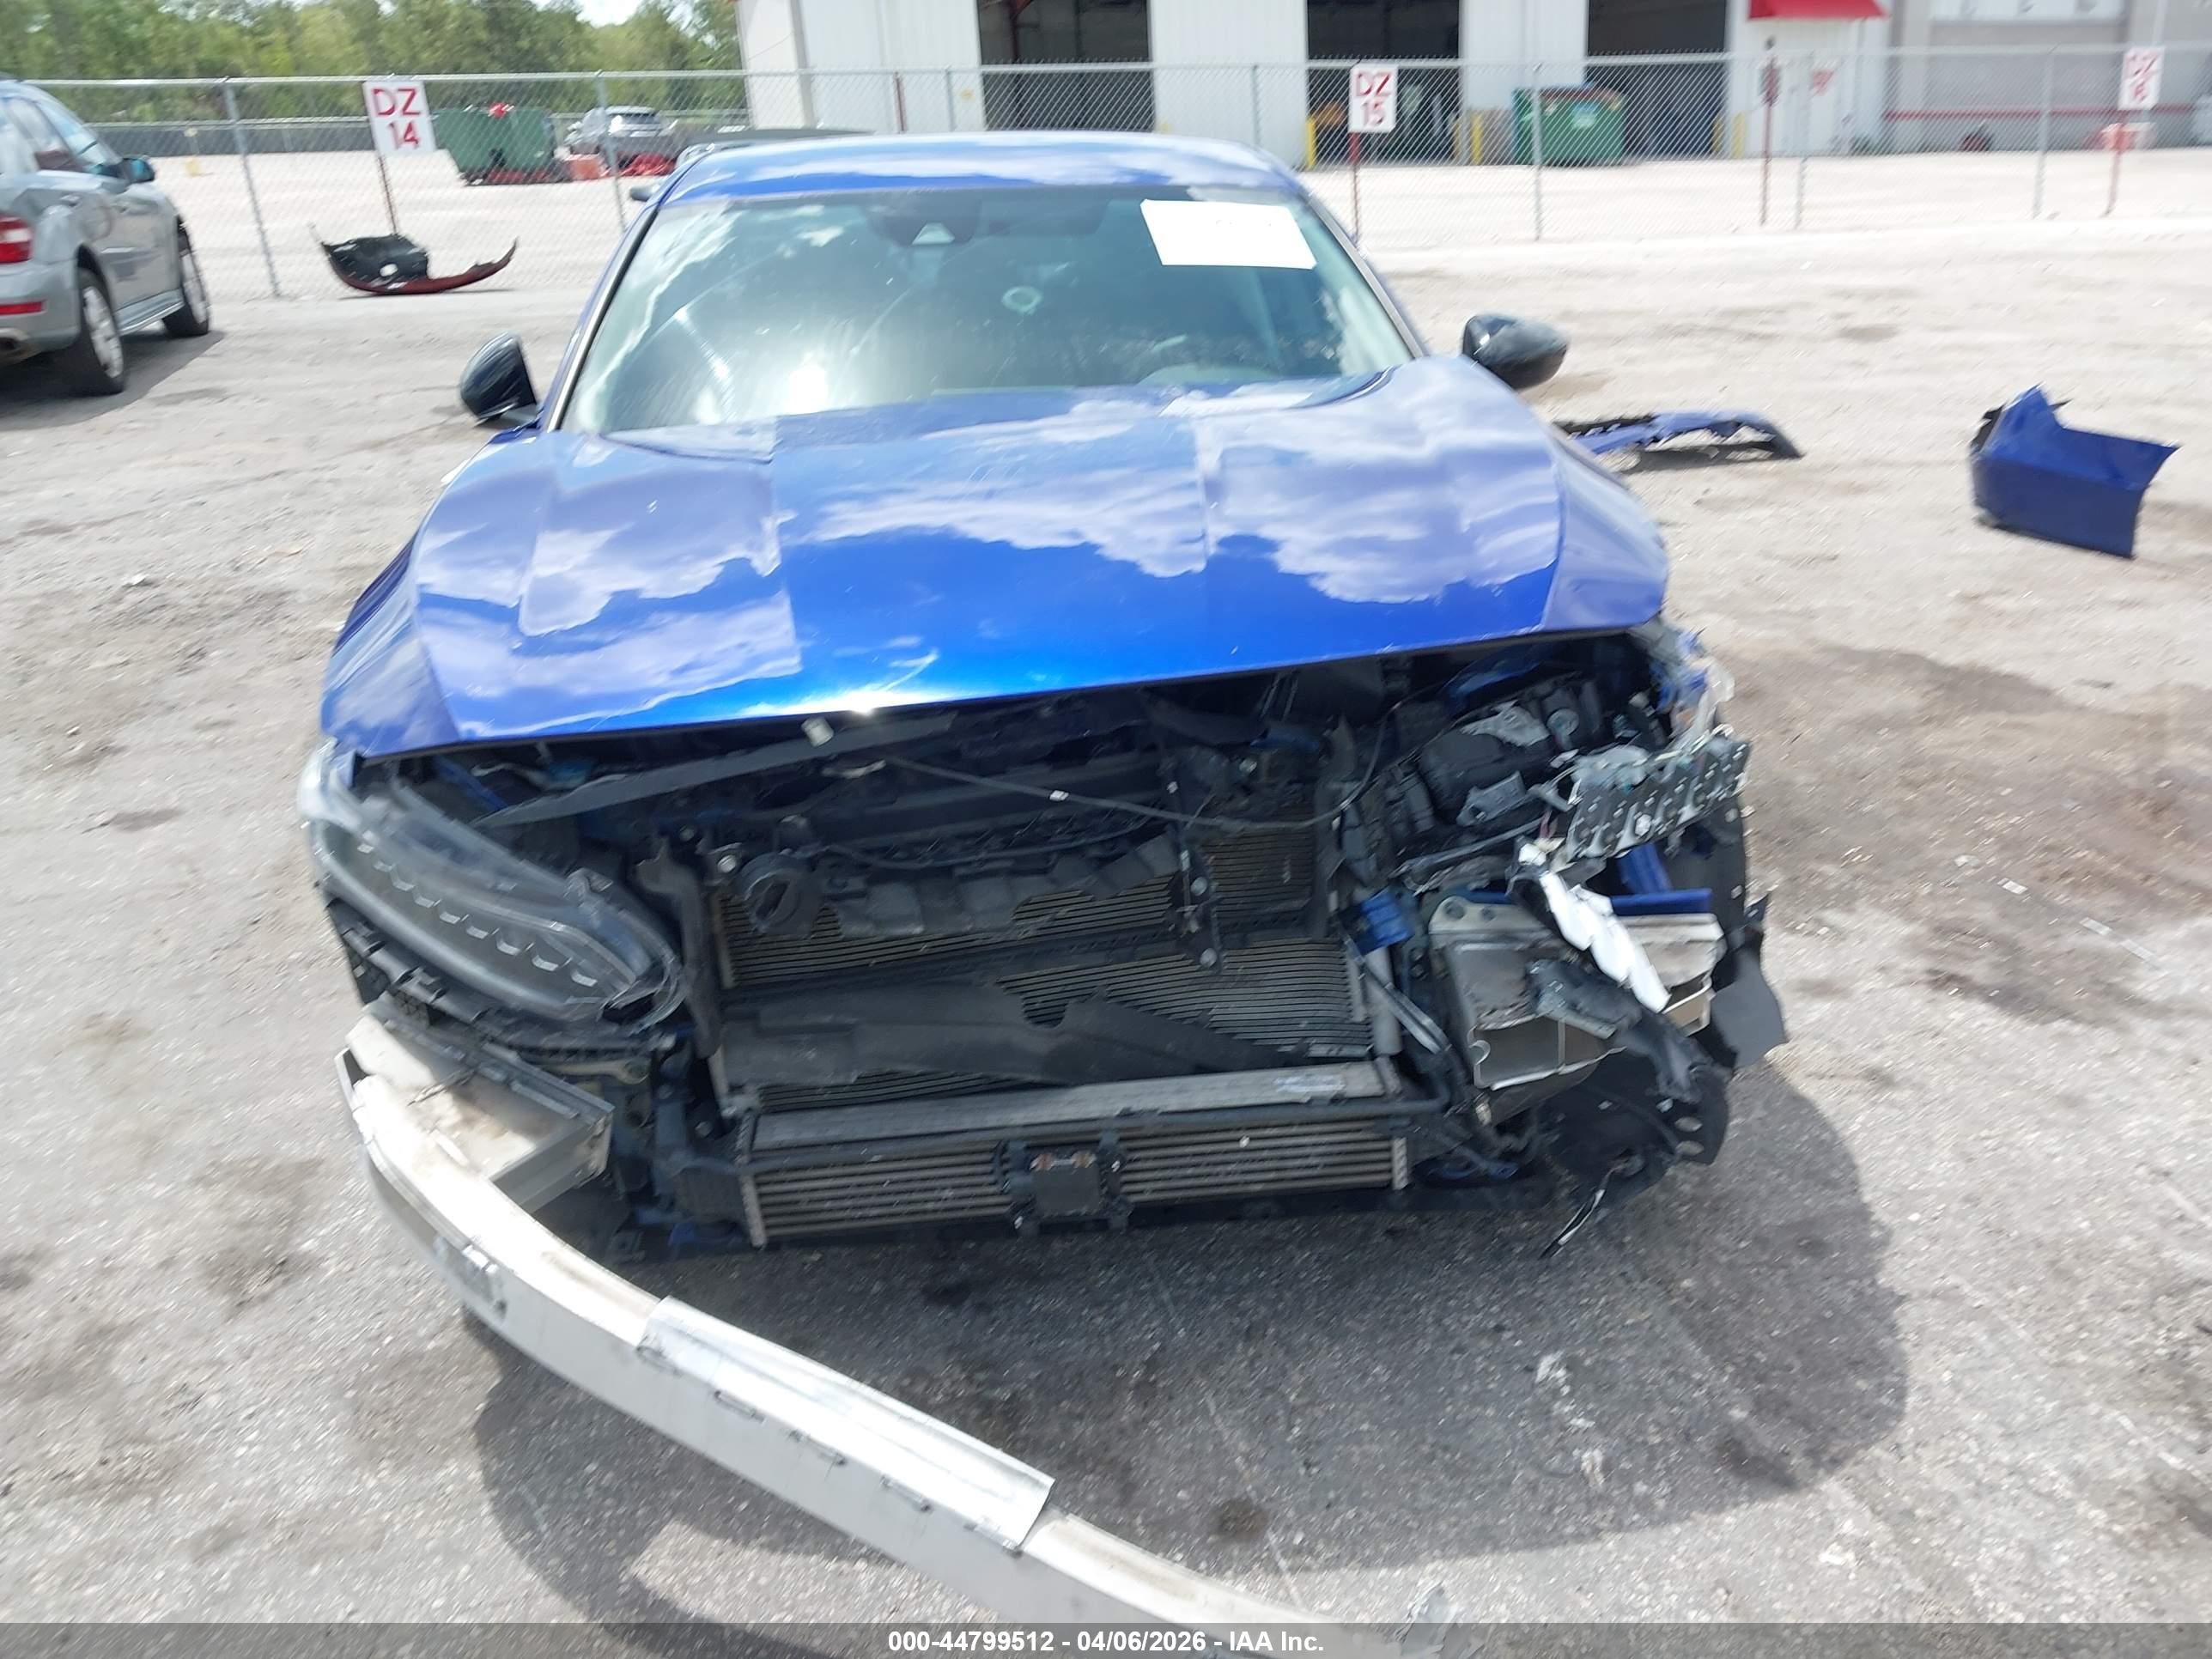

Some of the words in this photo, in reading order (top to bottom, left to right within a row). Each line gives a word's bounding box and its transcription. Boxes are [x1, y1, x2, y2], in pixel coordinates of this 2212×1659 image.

[1356, 71, 1393, 97] DZ
[372, 88, 422, 117] DZ
[388, 120, 421, 149] 14
